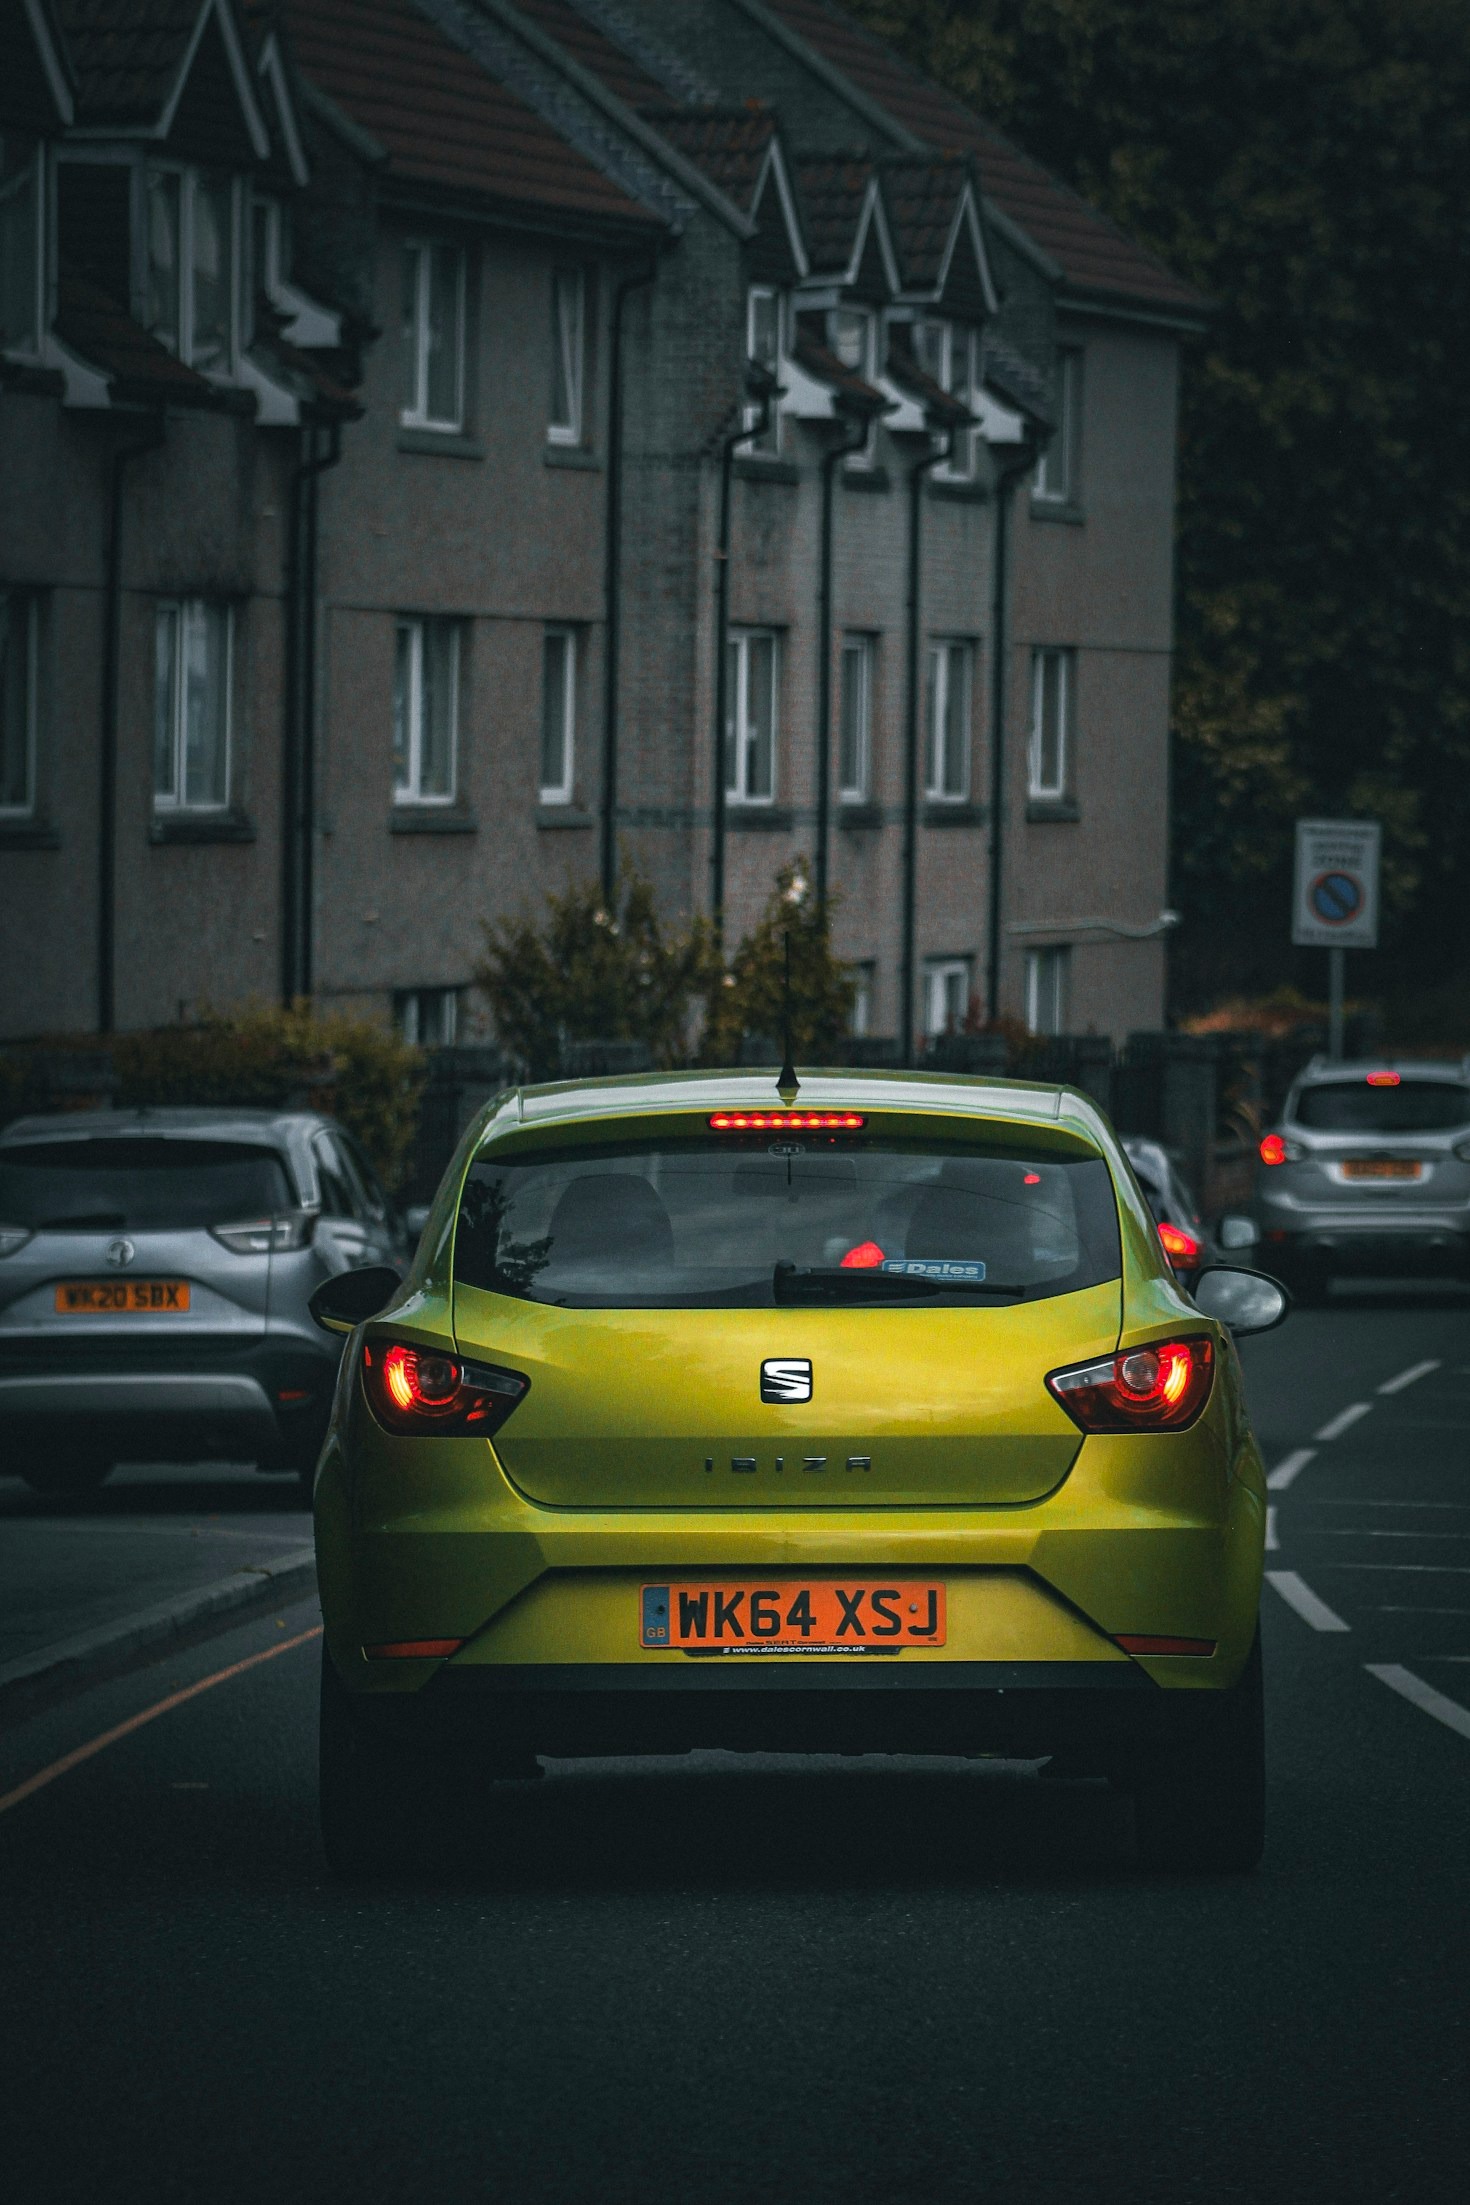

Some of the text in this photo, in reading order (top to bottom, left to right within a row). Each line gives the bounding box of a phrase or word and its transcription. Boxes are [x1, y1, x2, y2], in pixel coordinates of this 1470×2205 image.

[907, 1263, 979, 1275] Dales
[135, 1285, 179, 1308] SBX
[705, 1456, 871, 1473] IBIZA
[679, 1589, 937, 1638] WK64 XSJ
[646, 1627, 666, 1638] GB
[732, 1645, 866, 1653] www.dalescornwall.co.uk
